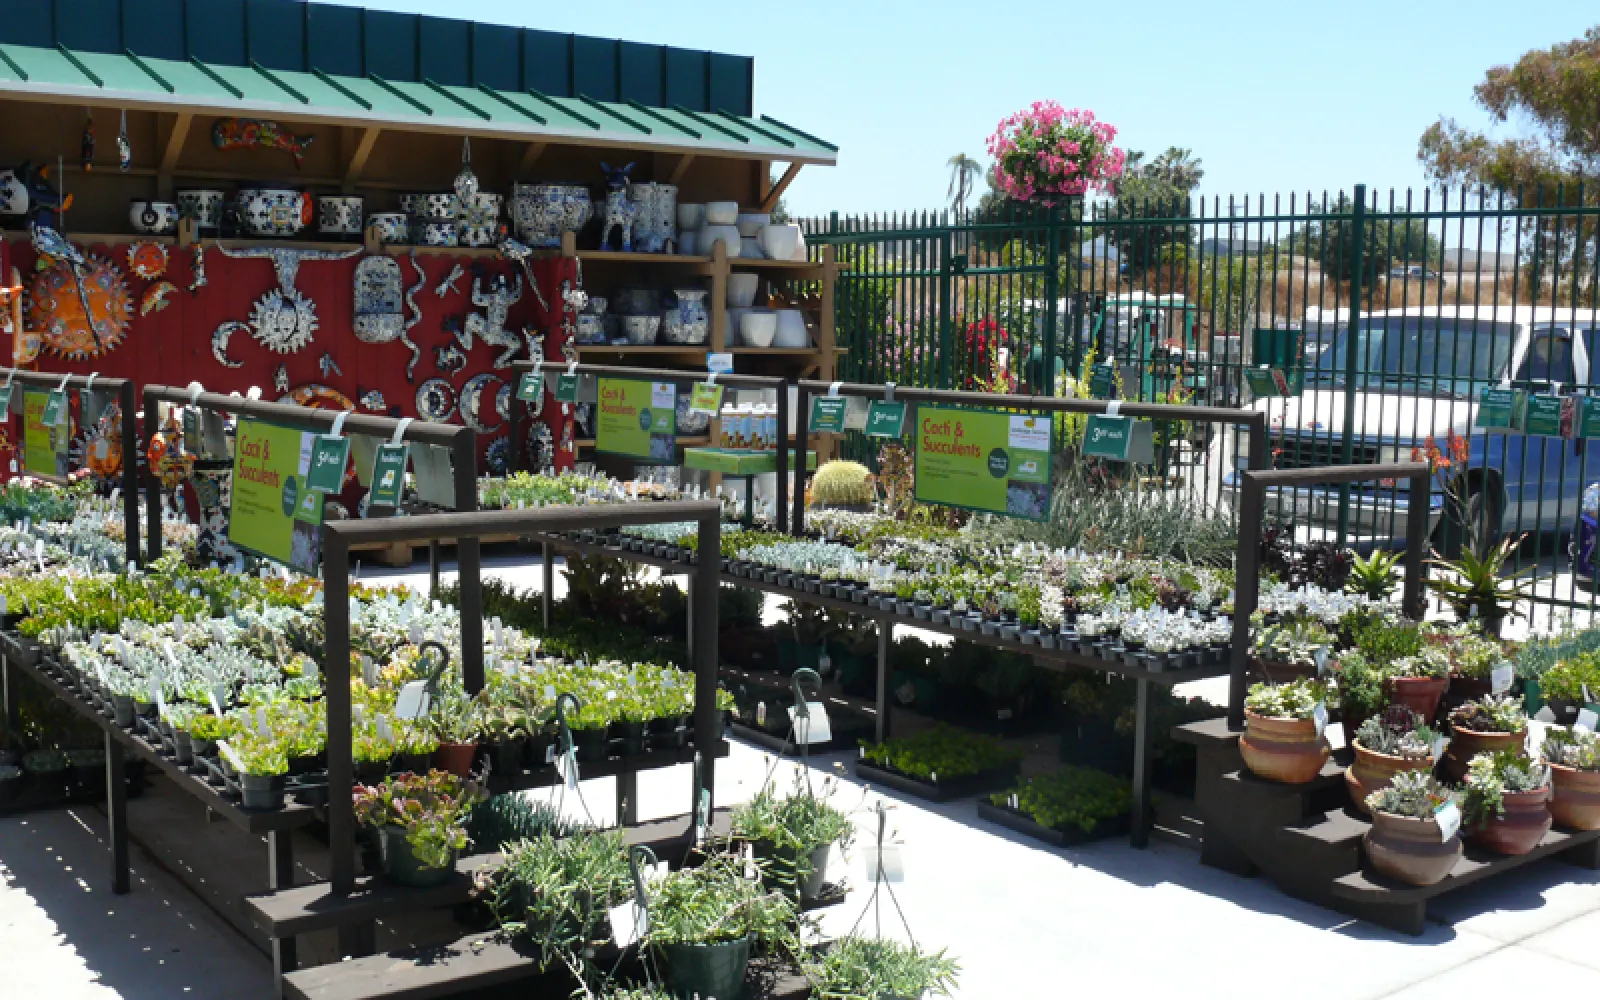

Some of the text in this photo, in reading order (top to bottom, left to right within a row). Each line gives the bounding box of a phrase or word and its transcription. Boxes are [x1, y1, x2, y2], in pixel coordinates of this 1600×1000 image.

[923, 417, 964, 437] Cacti &
[240, 434, 262, 458] Cacti
[923, 436, 981, 458] Succulents
[239, 457, 280, 488] Succulents
